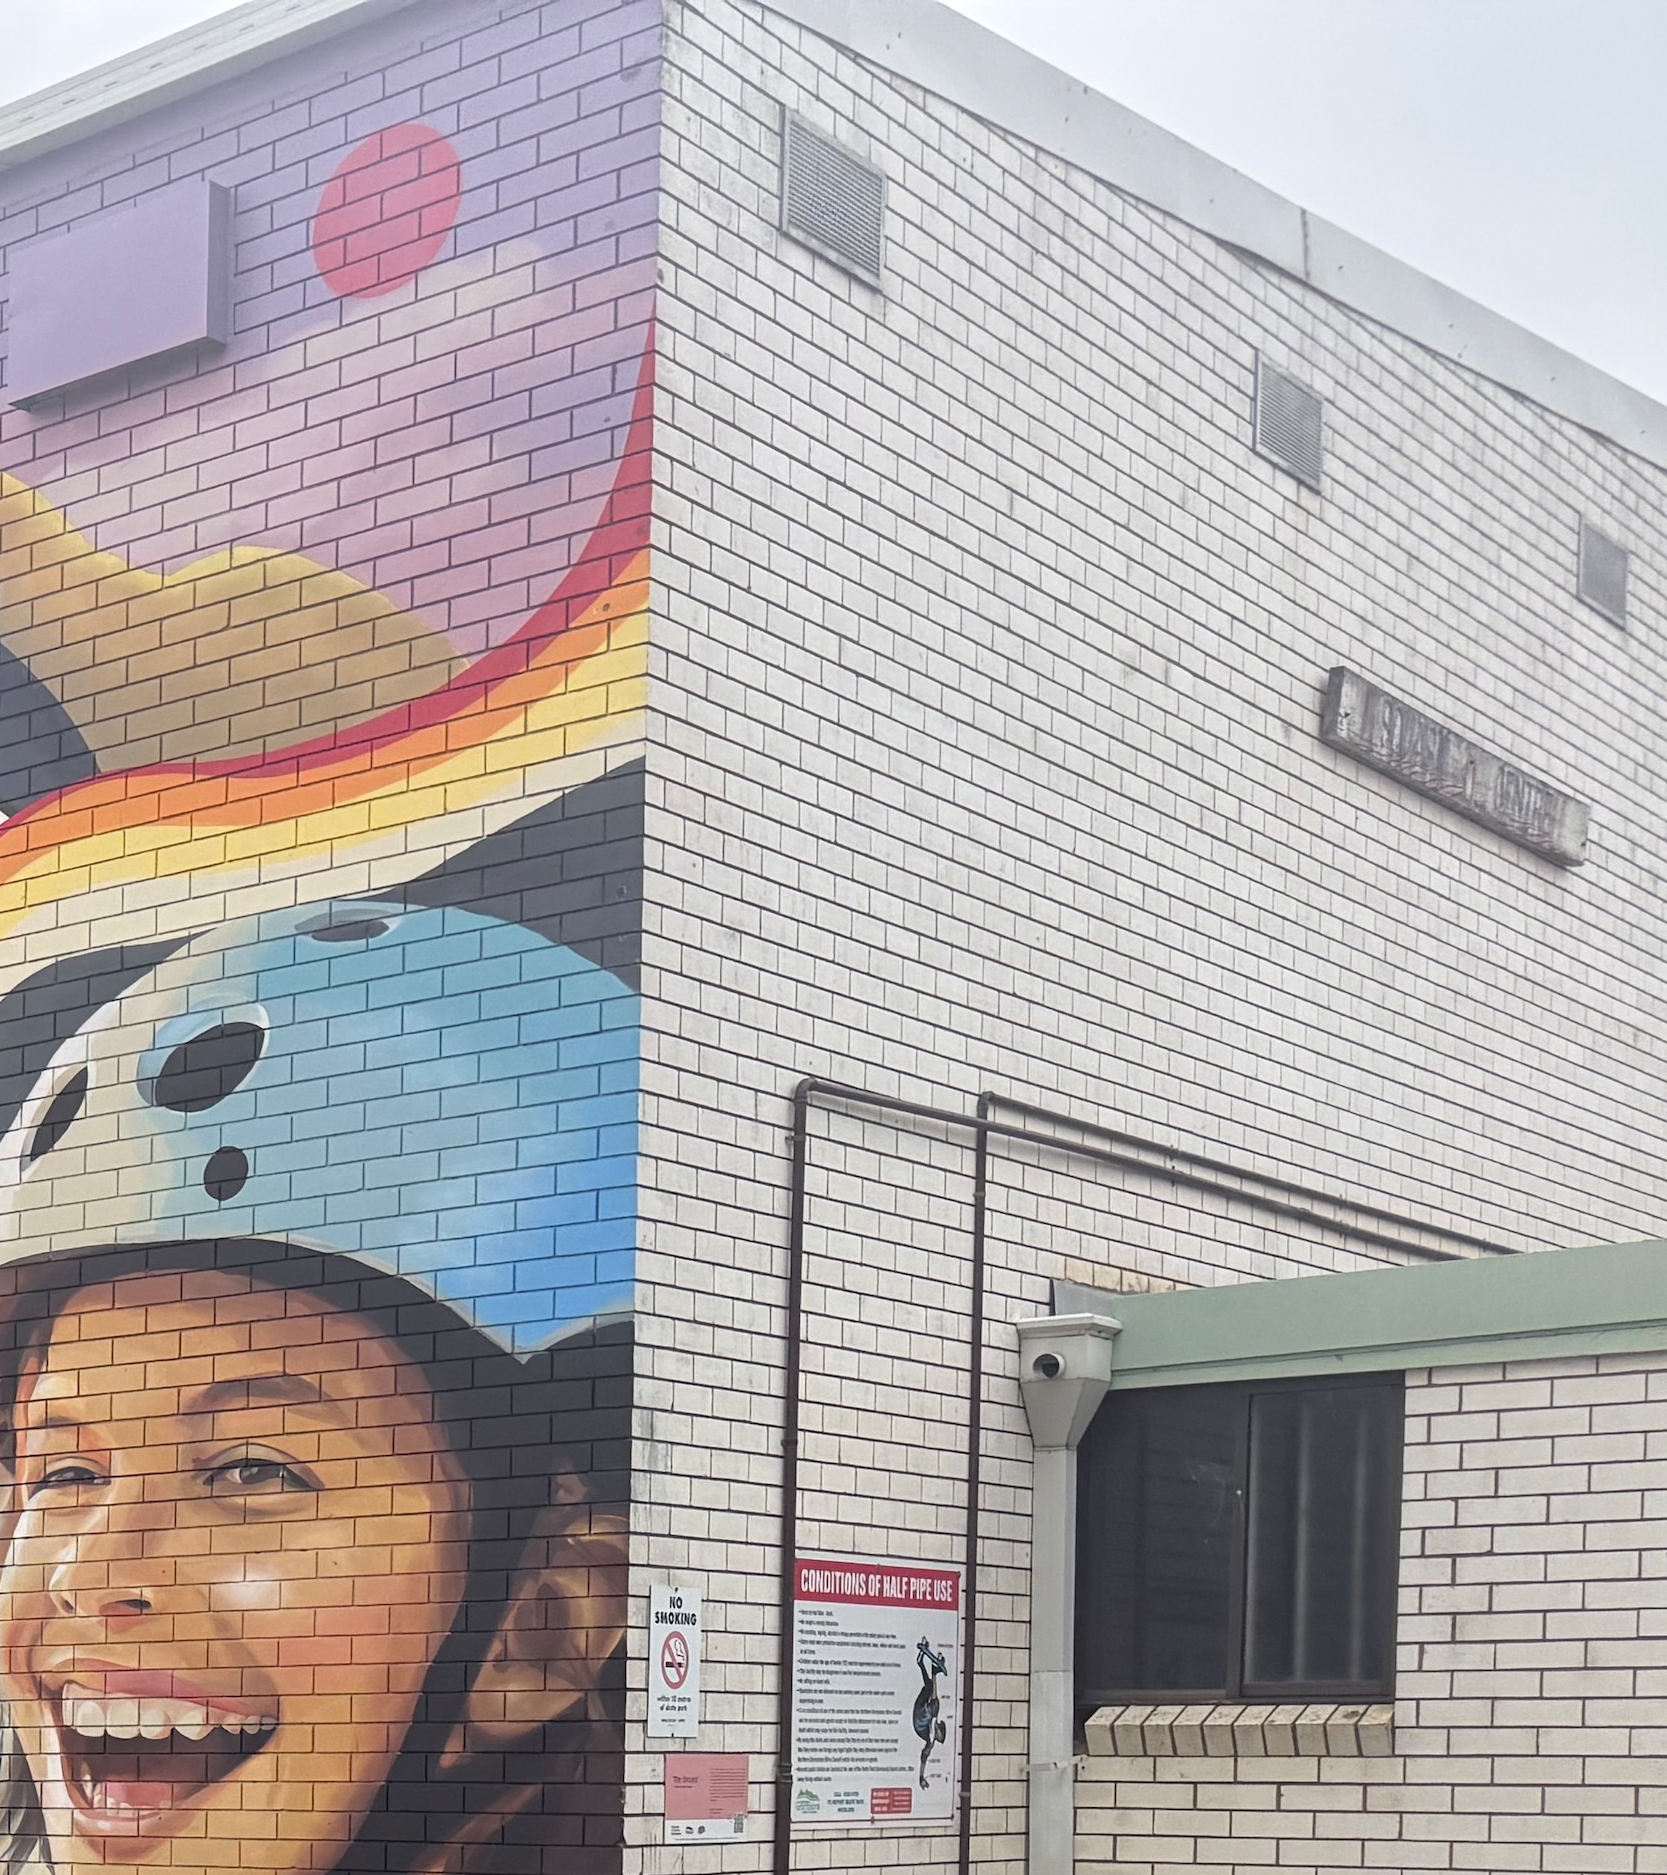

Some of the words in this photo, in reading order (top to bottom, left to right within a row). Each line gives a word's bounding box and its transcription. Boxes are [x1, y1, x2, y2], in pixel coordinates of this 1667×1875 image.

[801, 1568, 866, 1597] CONDITIONS
[868, 1573, 881, 1597] OF
[883, 1575, 908, 1599] HALF
[910, 1577, 932, 1601] PIPE
[934, 1580, 953, 1602] USE
[669, 1596, 683, 1609] NO
[654, 1611, 697, 1626] SMOKING
